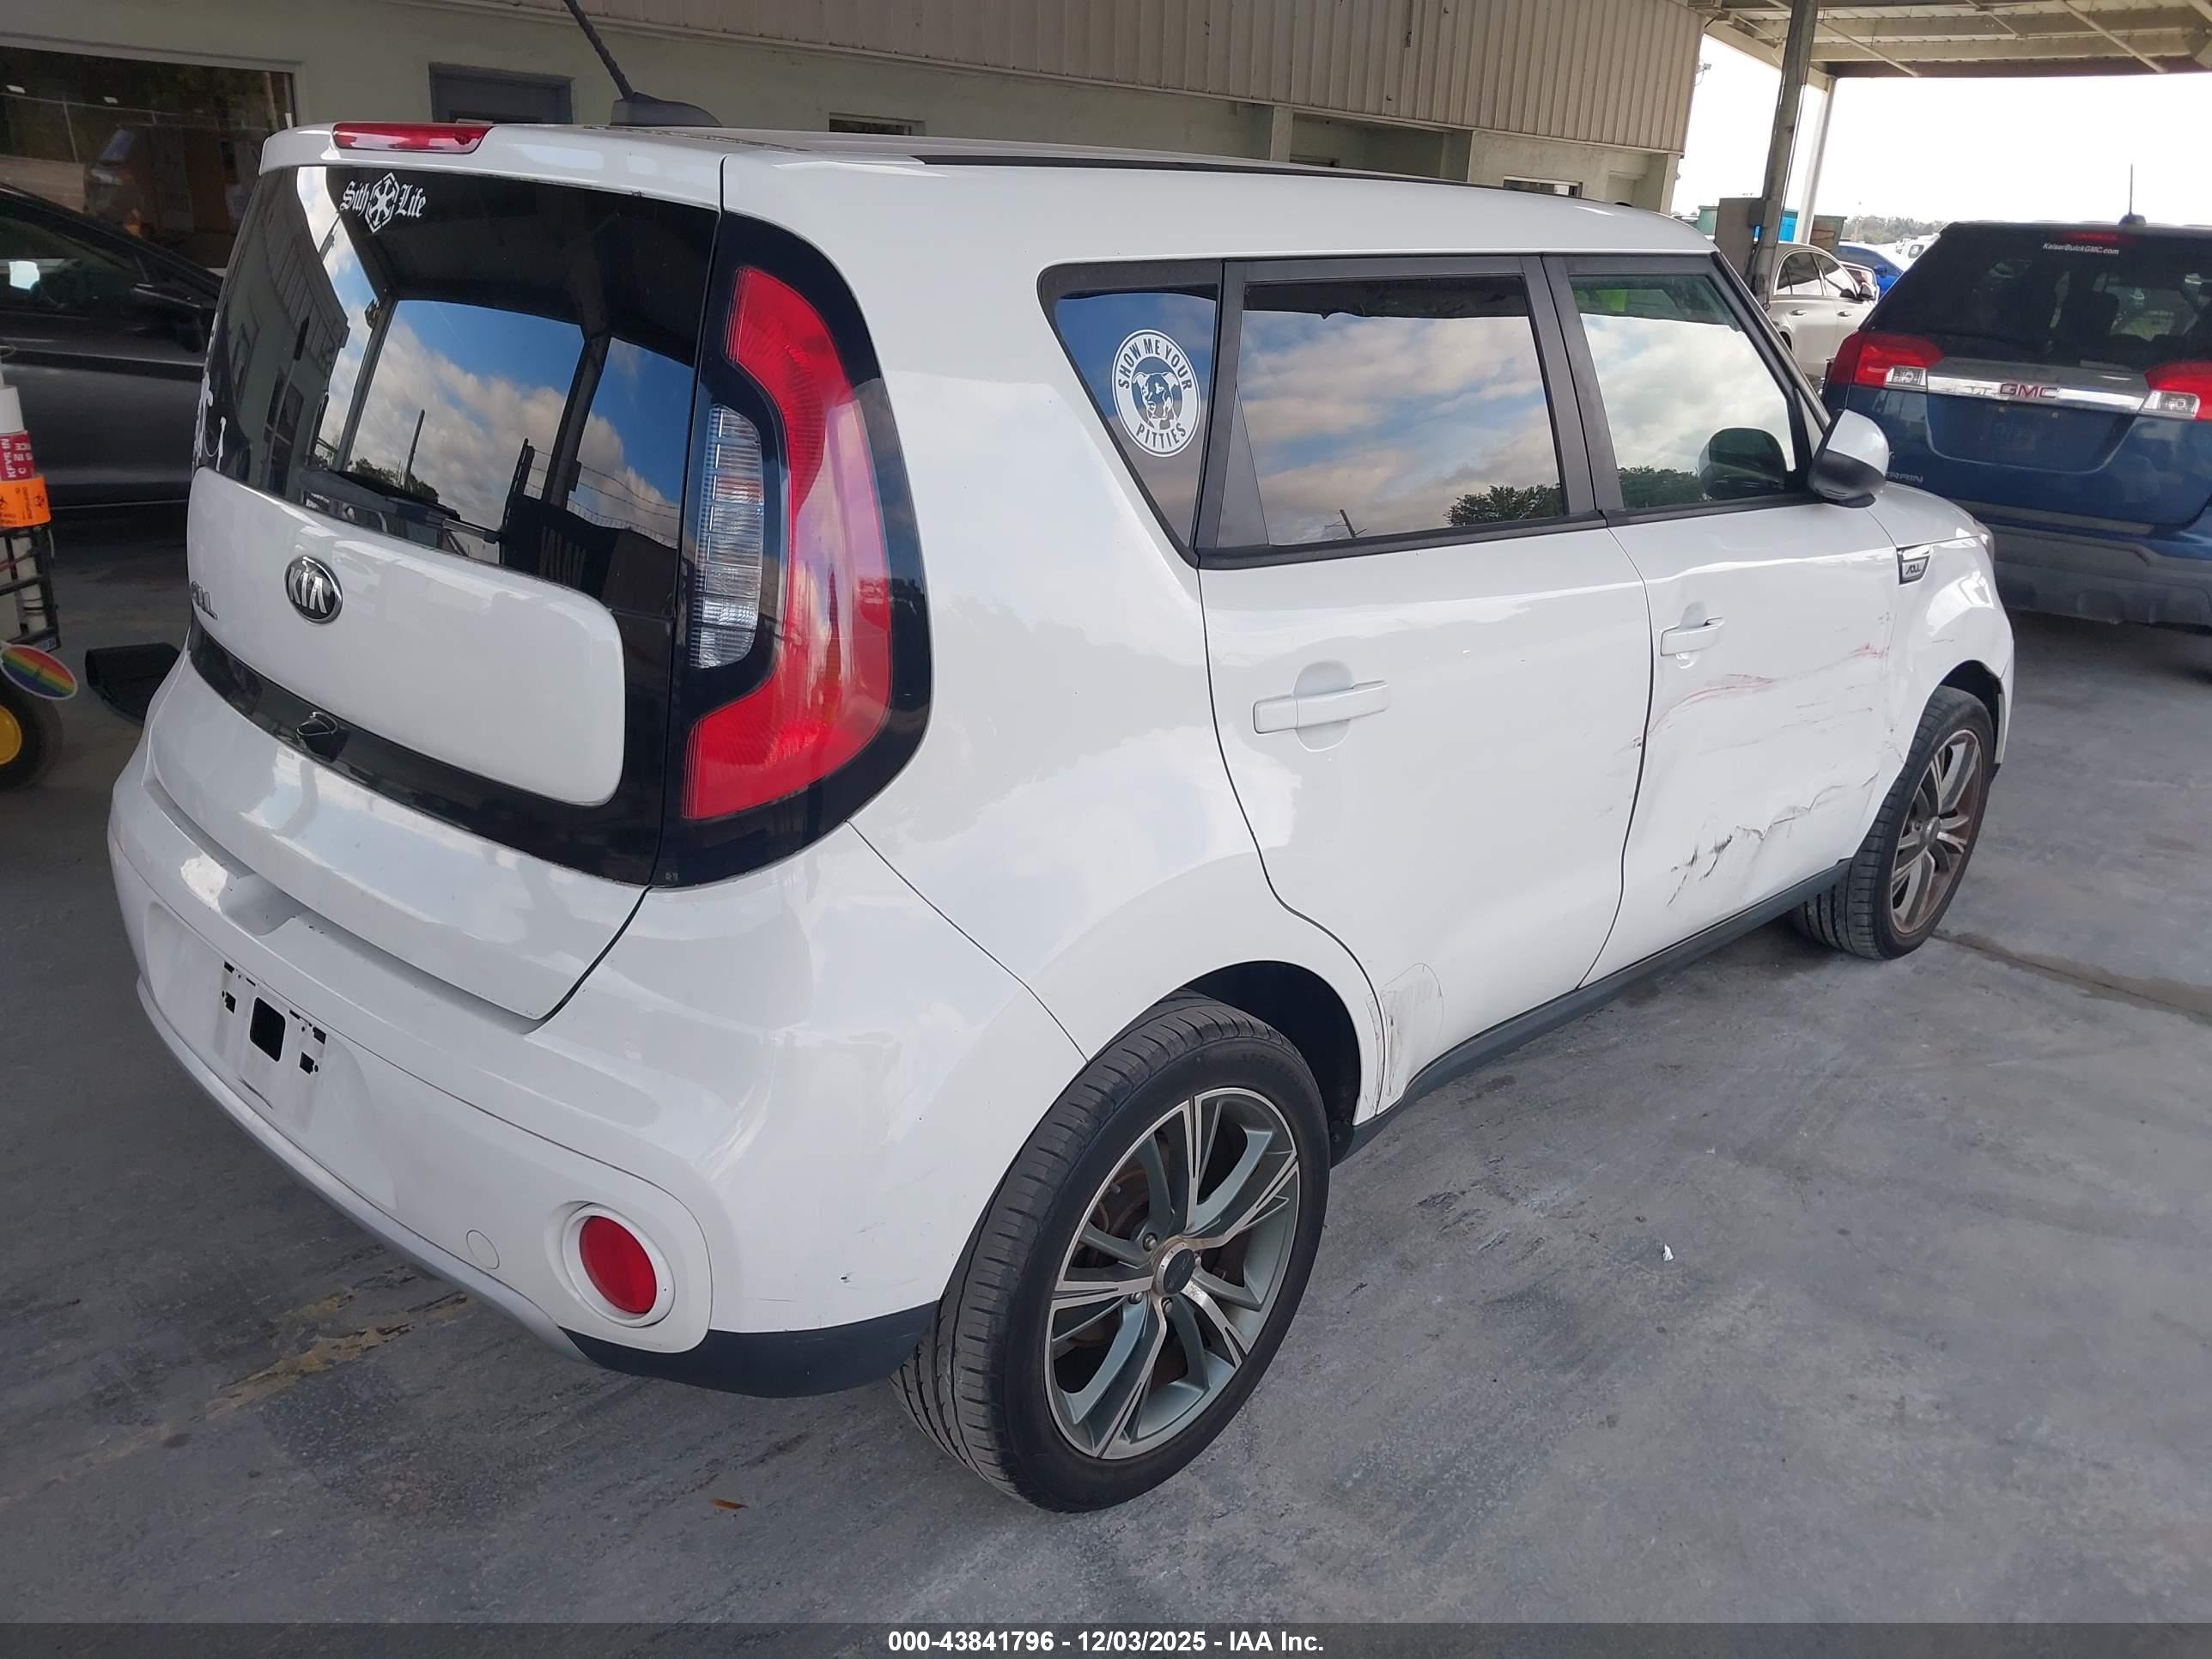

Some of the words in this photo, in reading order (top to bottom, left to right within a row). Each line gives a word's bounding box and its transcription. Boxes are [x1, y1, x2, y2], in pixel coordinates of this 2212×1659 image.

[339, 180, 370, 217] Sith
[395, 185, 427, 219] Life
[1117, 341, 1142, 390] SHOW
[1143, 337, 1161, 356] ME
[1164, 344, 1193, 391] YOUR
[1999, 383, 2059, 399] GMC
[1136, 422, 1187, 449] PITTIES
[288, 566, 327, 614] KIA
